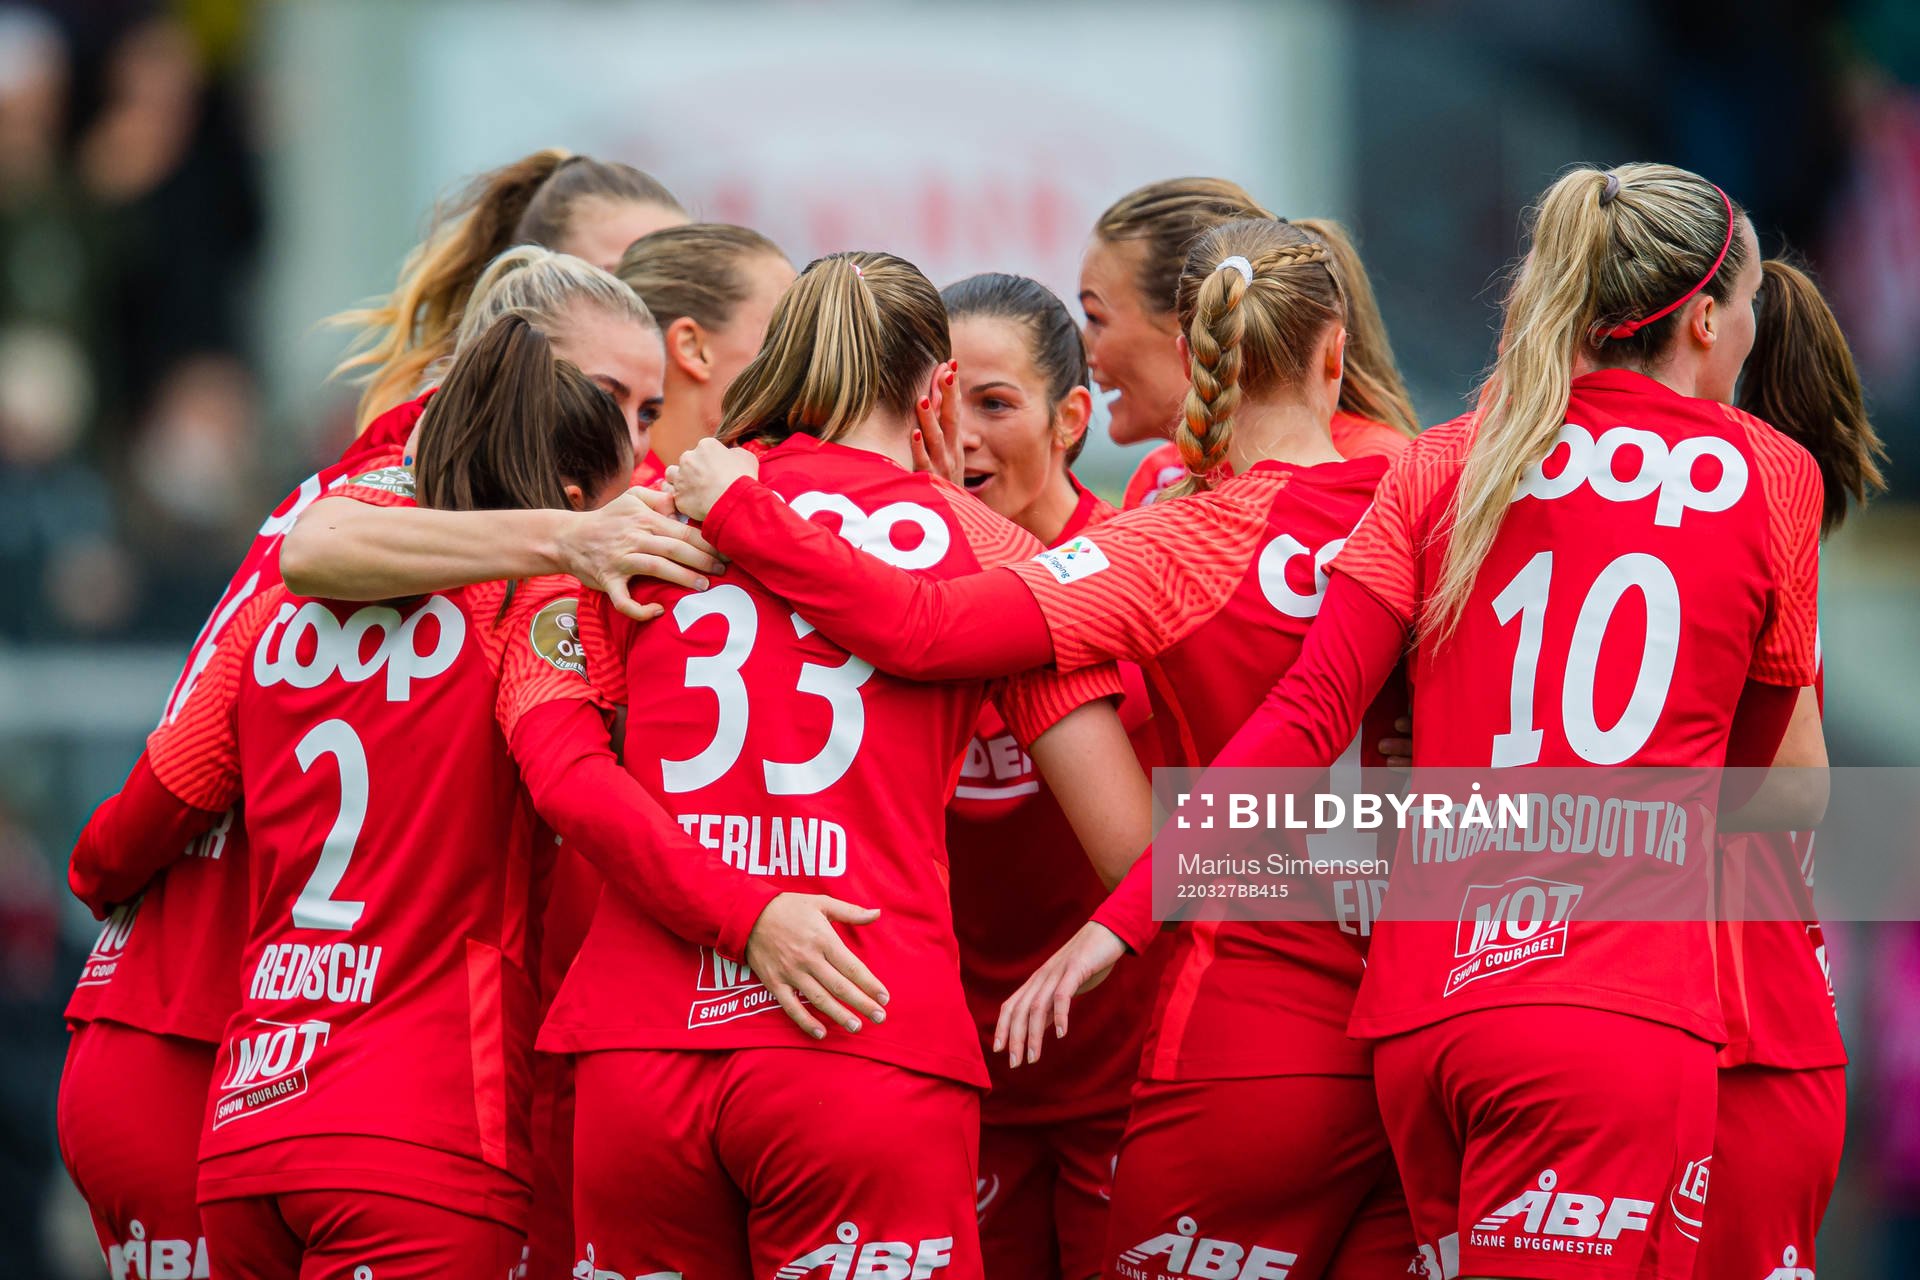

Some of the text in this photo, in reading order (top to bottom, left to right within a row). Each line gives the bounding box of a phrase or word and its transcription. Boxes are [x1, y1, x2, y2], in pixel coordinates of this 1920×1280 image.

[1509, 423, 1749, 528] oop
[253, 594, 467, 702] coop
[1489, 550, 1682, 770] 10
[660, 583, 877, 797] 33
[291, 718, 370, 931] 2
[1469, 885, 1584, 955] MOT
[249, 943, 383, 1004] REDISCH
[1453, 936, 1556, 985] SHOW COURAGE!
[699, 999, 739, 1019] SHOW
[230, 1022, 331, 1086] MOT
[217, 1076, 299, 1119] SHOW COURAGE!
[1473, 1168, 1655, 1240] ÅBF
[1678, 1161, 1711, 1205] LE
[1470, 1230, 1613, 1256] ÅSANE BYGGMESTER
